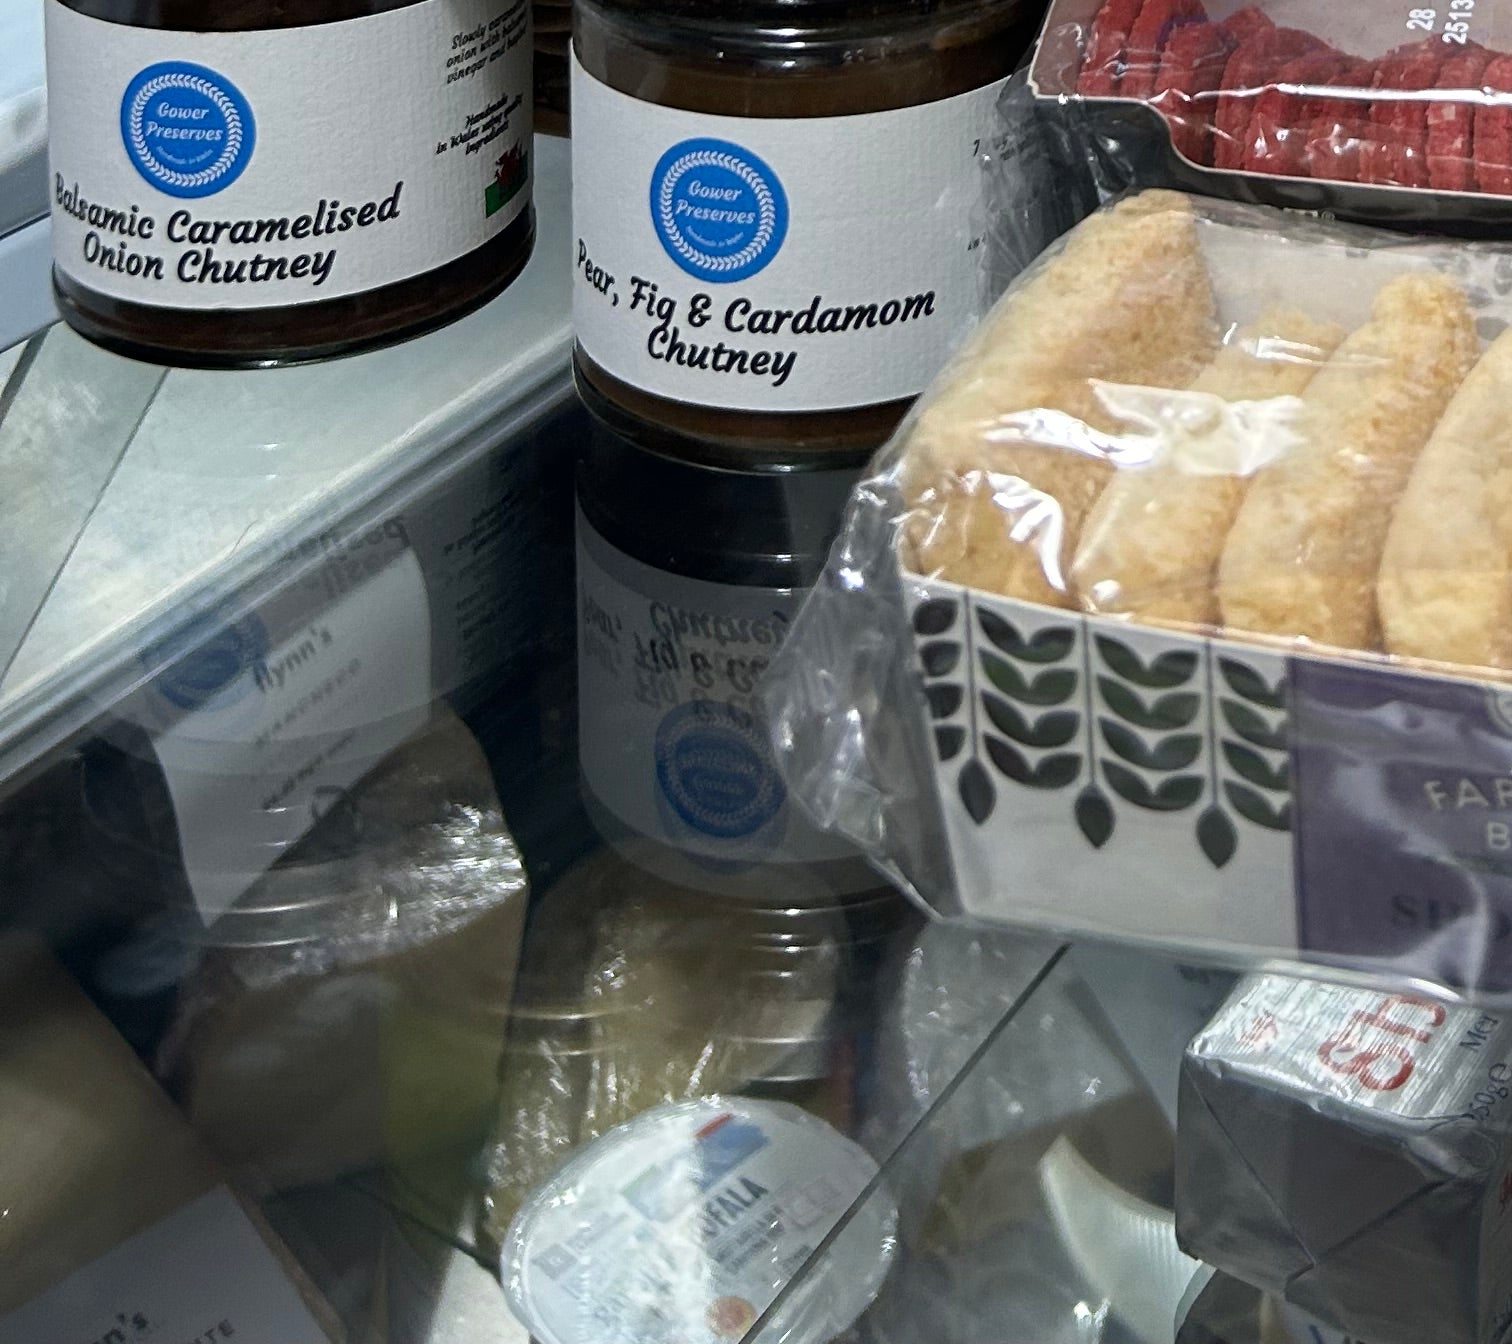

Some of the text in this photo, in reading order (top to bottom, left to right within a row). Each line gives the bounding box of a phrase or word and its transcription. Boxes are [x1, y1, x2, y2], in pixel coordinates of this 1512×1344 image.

[1406, 8, 1437, 31] 28
[157, 102, 210, 120] Gower
[145, 121, 223, 141] Preserves
[688, 180, 742, 201] Gower
[55, 171, 405, 244] Balsamic Caramelised
[675, 199, 756, 224] Preserves
[84, 230, 337, 286] Onion Chutney
[577, 238, 935, 335] Pear, Fig & Cardamom
[647, 325, 798, 388] Chutney
